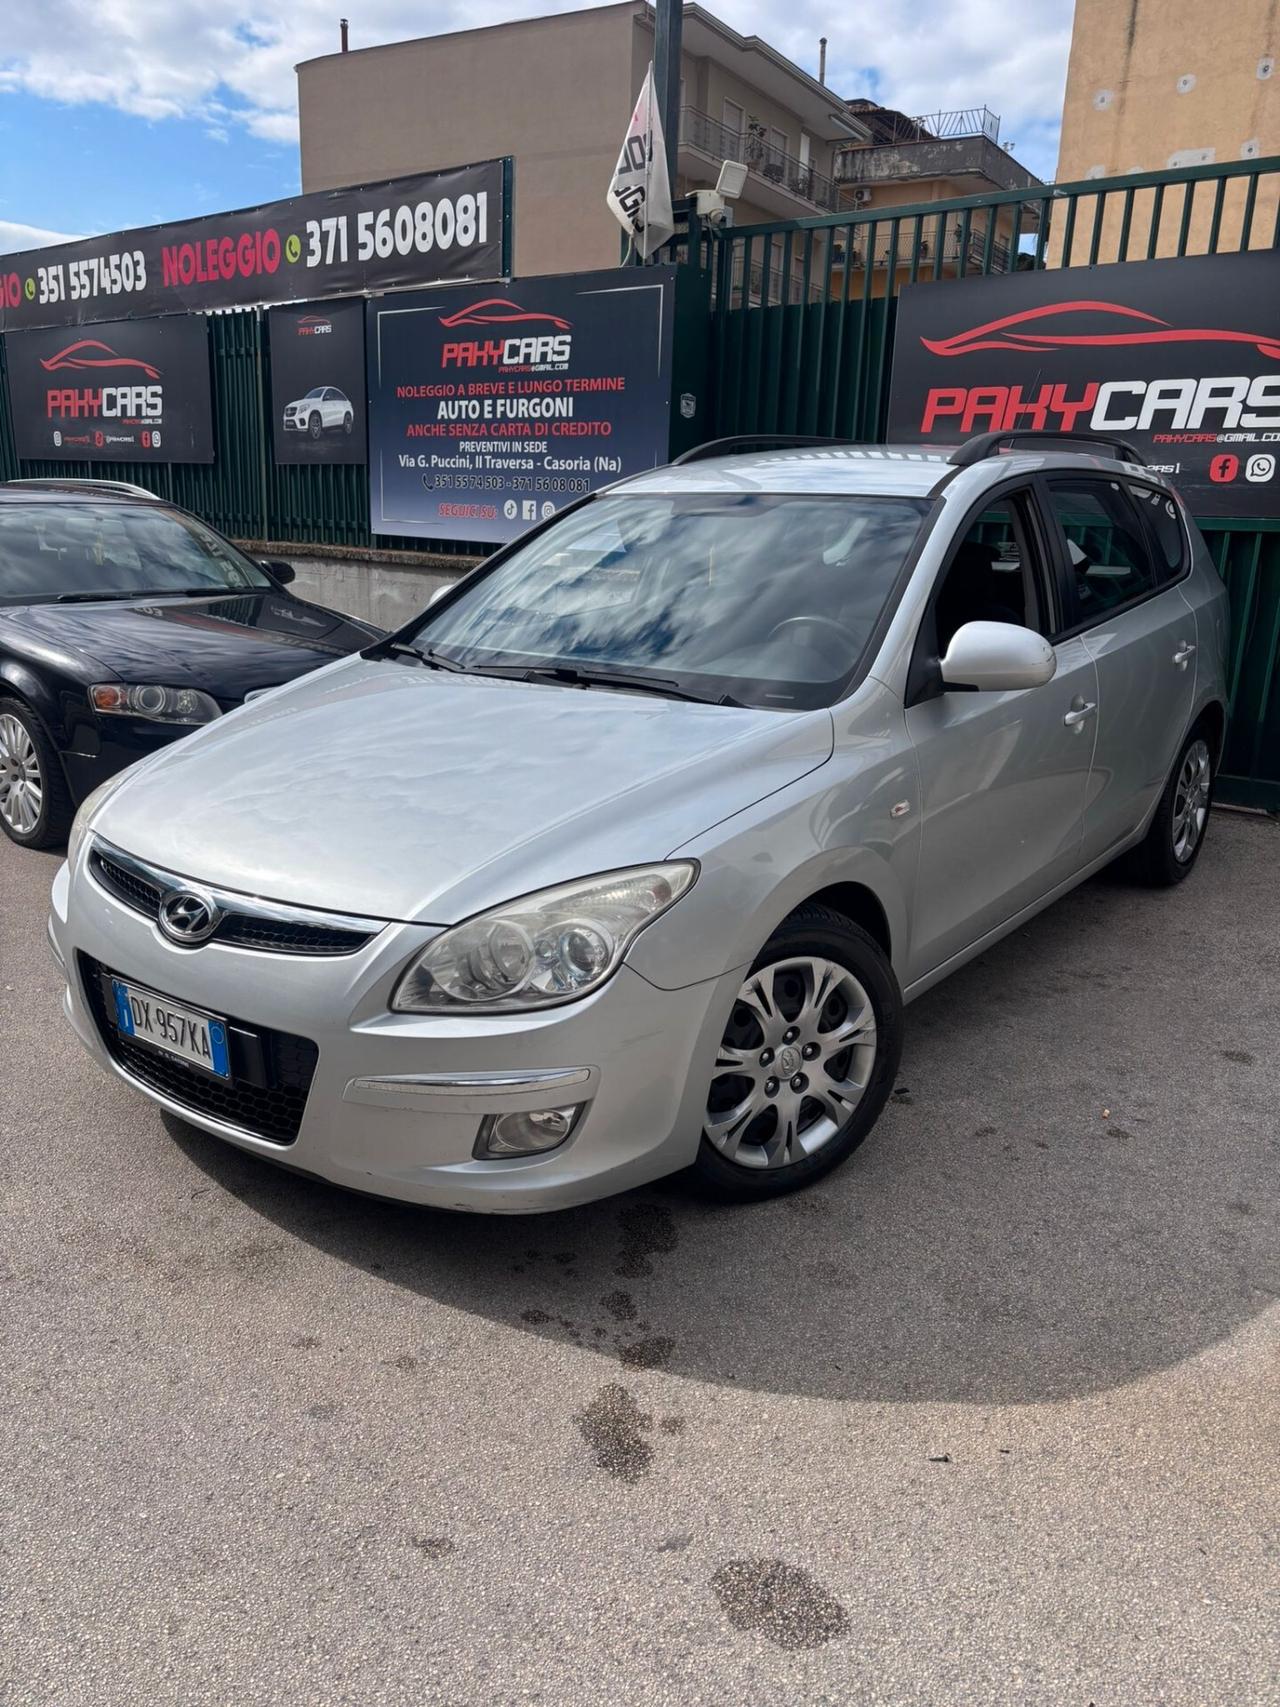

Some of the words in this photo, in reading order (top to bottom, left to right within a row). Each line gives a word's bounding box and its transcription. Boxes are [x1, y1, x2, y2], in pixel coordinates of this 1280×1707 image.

[0, 271, 21, 309] IO
[37, 264, 66, 304] 351
[69, 250, 147, 300] 5574503
[161, 228, 281, 288] NOLEGGIO
[306, 215, 349, 268] 371
[357, 191, 488, 261] 5608081
[397, 384, 455, 398] NOLEGGIO
[457, 384, 466, 395] A
[468, 382, 506, 396] BREVE
[508, 381, 515, 394] E
[517, 380, 562, 393] LUNGO
[565, 377, 625, 392] TERMINE
[437, 400, 480, 420] AUTO
[484, 400, 493, 418] E
[496, 397, 574, 418] FURGONI
[921, 375, 1280, 432] PAKYCARS
[406, 424, 447, 437] ANCHE
[448, 423, 488, 436] SENZA
[490, 423, 531, 436] CARTA
[534, 422, 548, 436] DI
[552, 422, 612, 436] CREDITO
[1152, 432, 1280, 444] PAKYCARS@GMAIL.CO
[459, 441, 510, 453] PREVENTIVI
[512, 441, 522, 453] IN
[523, 441, 548, 453] SEDE
[398, 455, 415, 467] Via
[418, 455, 429, 467] G.
[431, 455, 473, 470] Puccini,
[484, 456, 533, 469] Traversa
[544, 456, 591, 470] Casoria
[594, 456, 621, 473] (Na)
[435, 475, 453, 487] 351
[455, 475, 468, 488] 55
[470, 476, 483, 488] 74
[485, 476, 505, 489] 503
[513, 477, 533, 491] 371
[535, 477, 549, 491] 56
[552, 477, 566, 492] 08
[568, 478, 591, 493] 081
[439, 503, 479, 518] SEGUICI
[130, 996, 154, 1033] DX
[156, 1007, 212, 1060] 957KA
